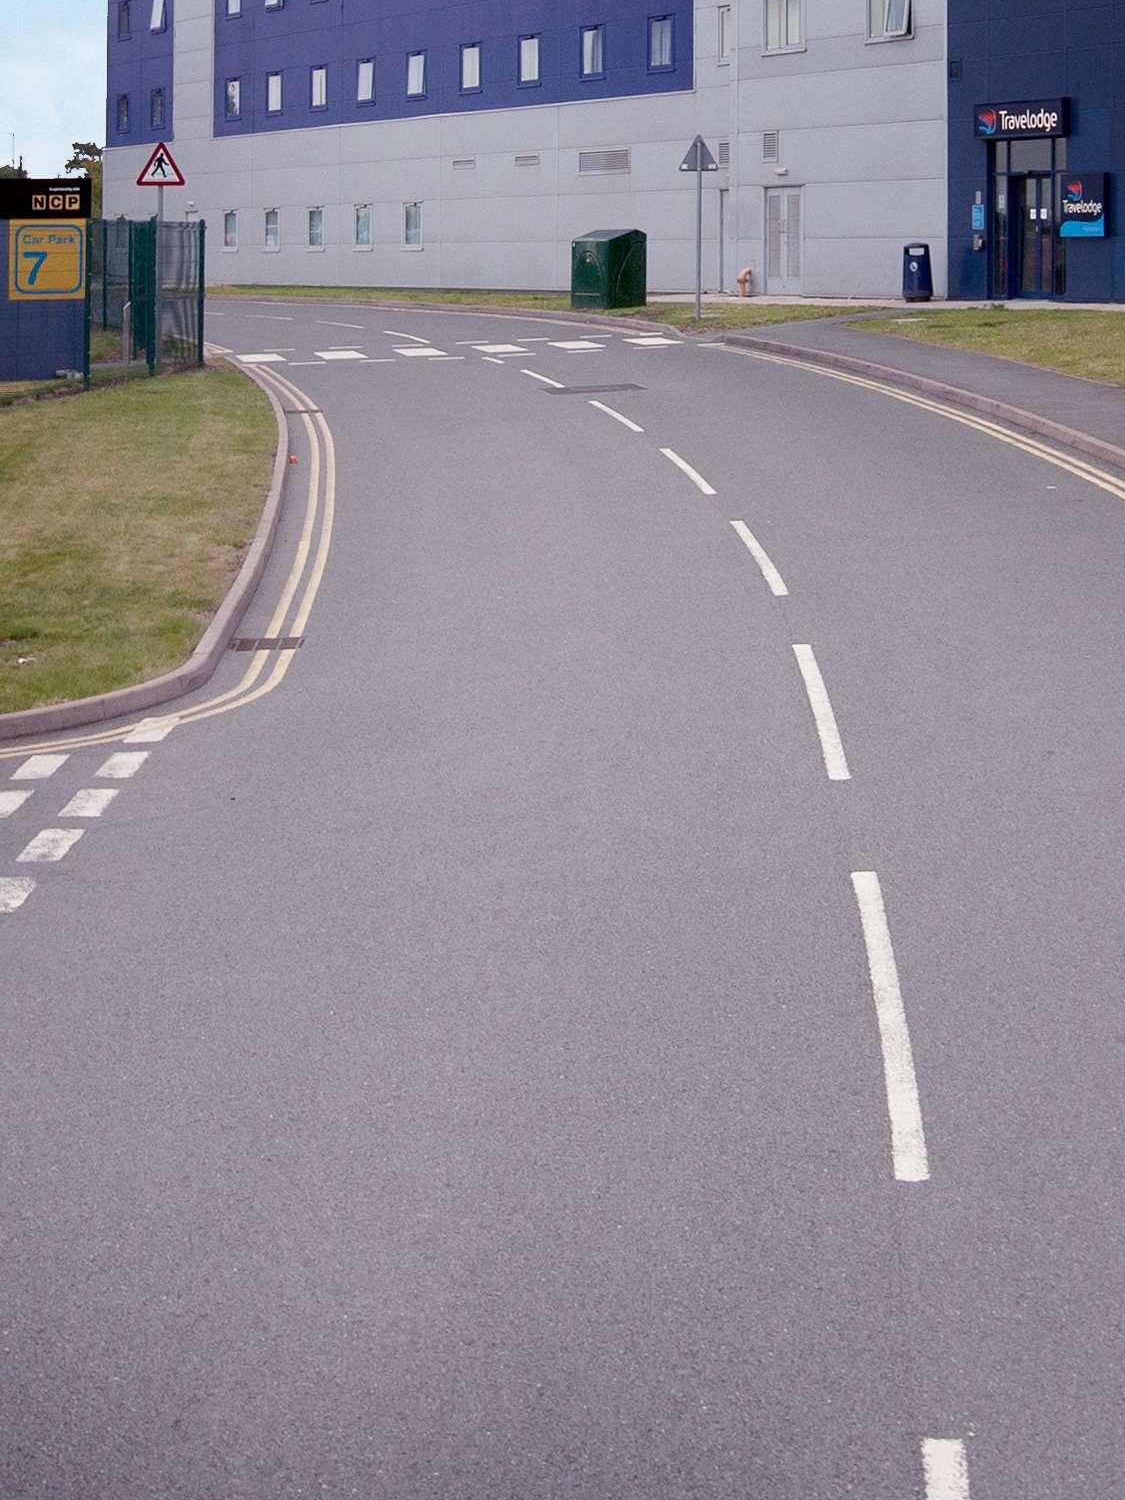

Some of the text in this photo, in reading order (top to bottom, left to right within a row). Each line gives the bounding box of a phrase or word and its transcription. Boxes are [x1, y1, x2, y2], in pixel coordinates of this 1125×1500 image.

[998, 108, 1058, 132] Travelodge
[32, 195, 80, 210] NCP
[1062, 199, 1102, 216] Travelodge
[23, 234, 76, 244] Car Park
[23, 251, 48, 286] 7
